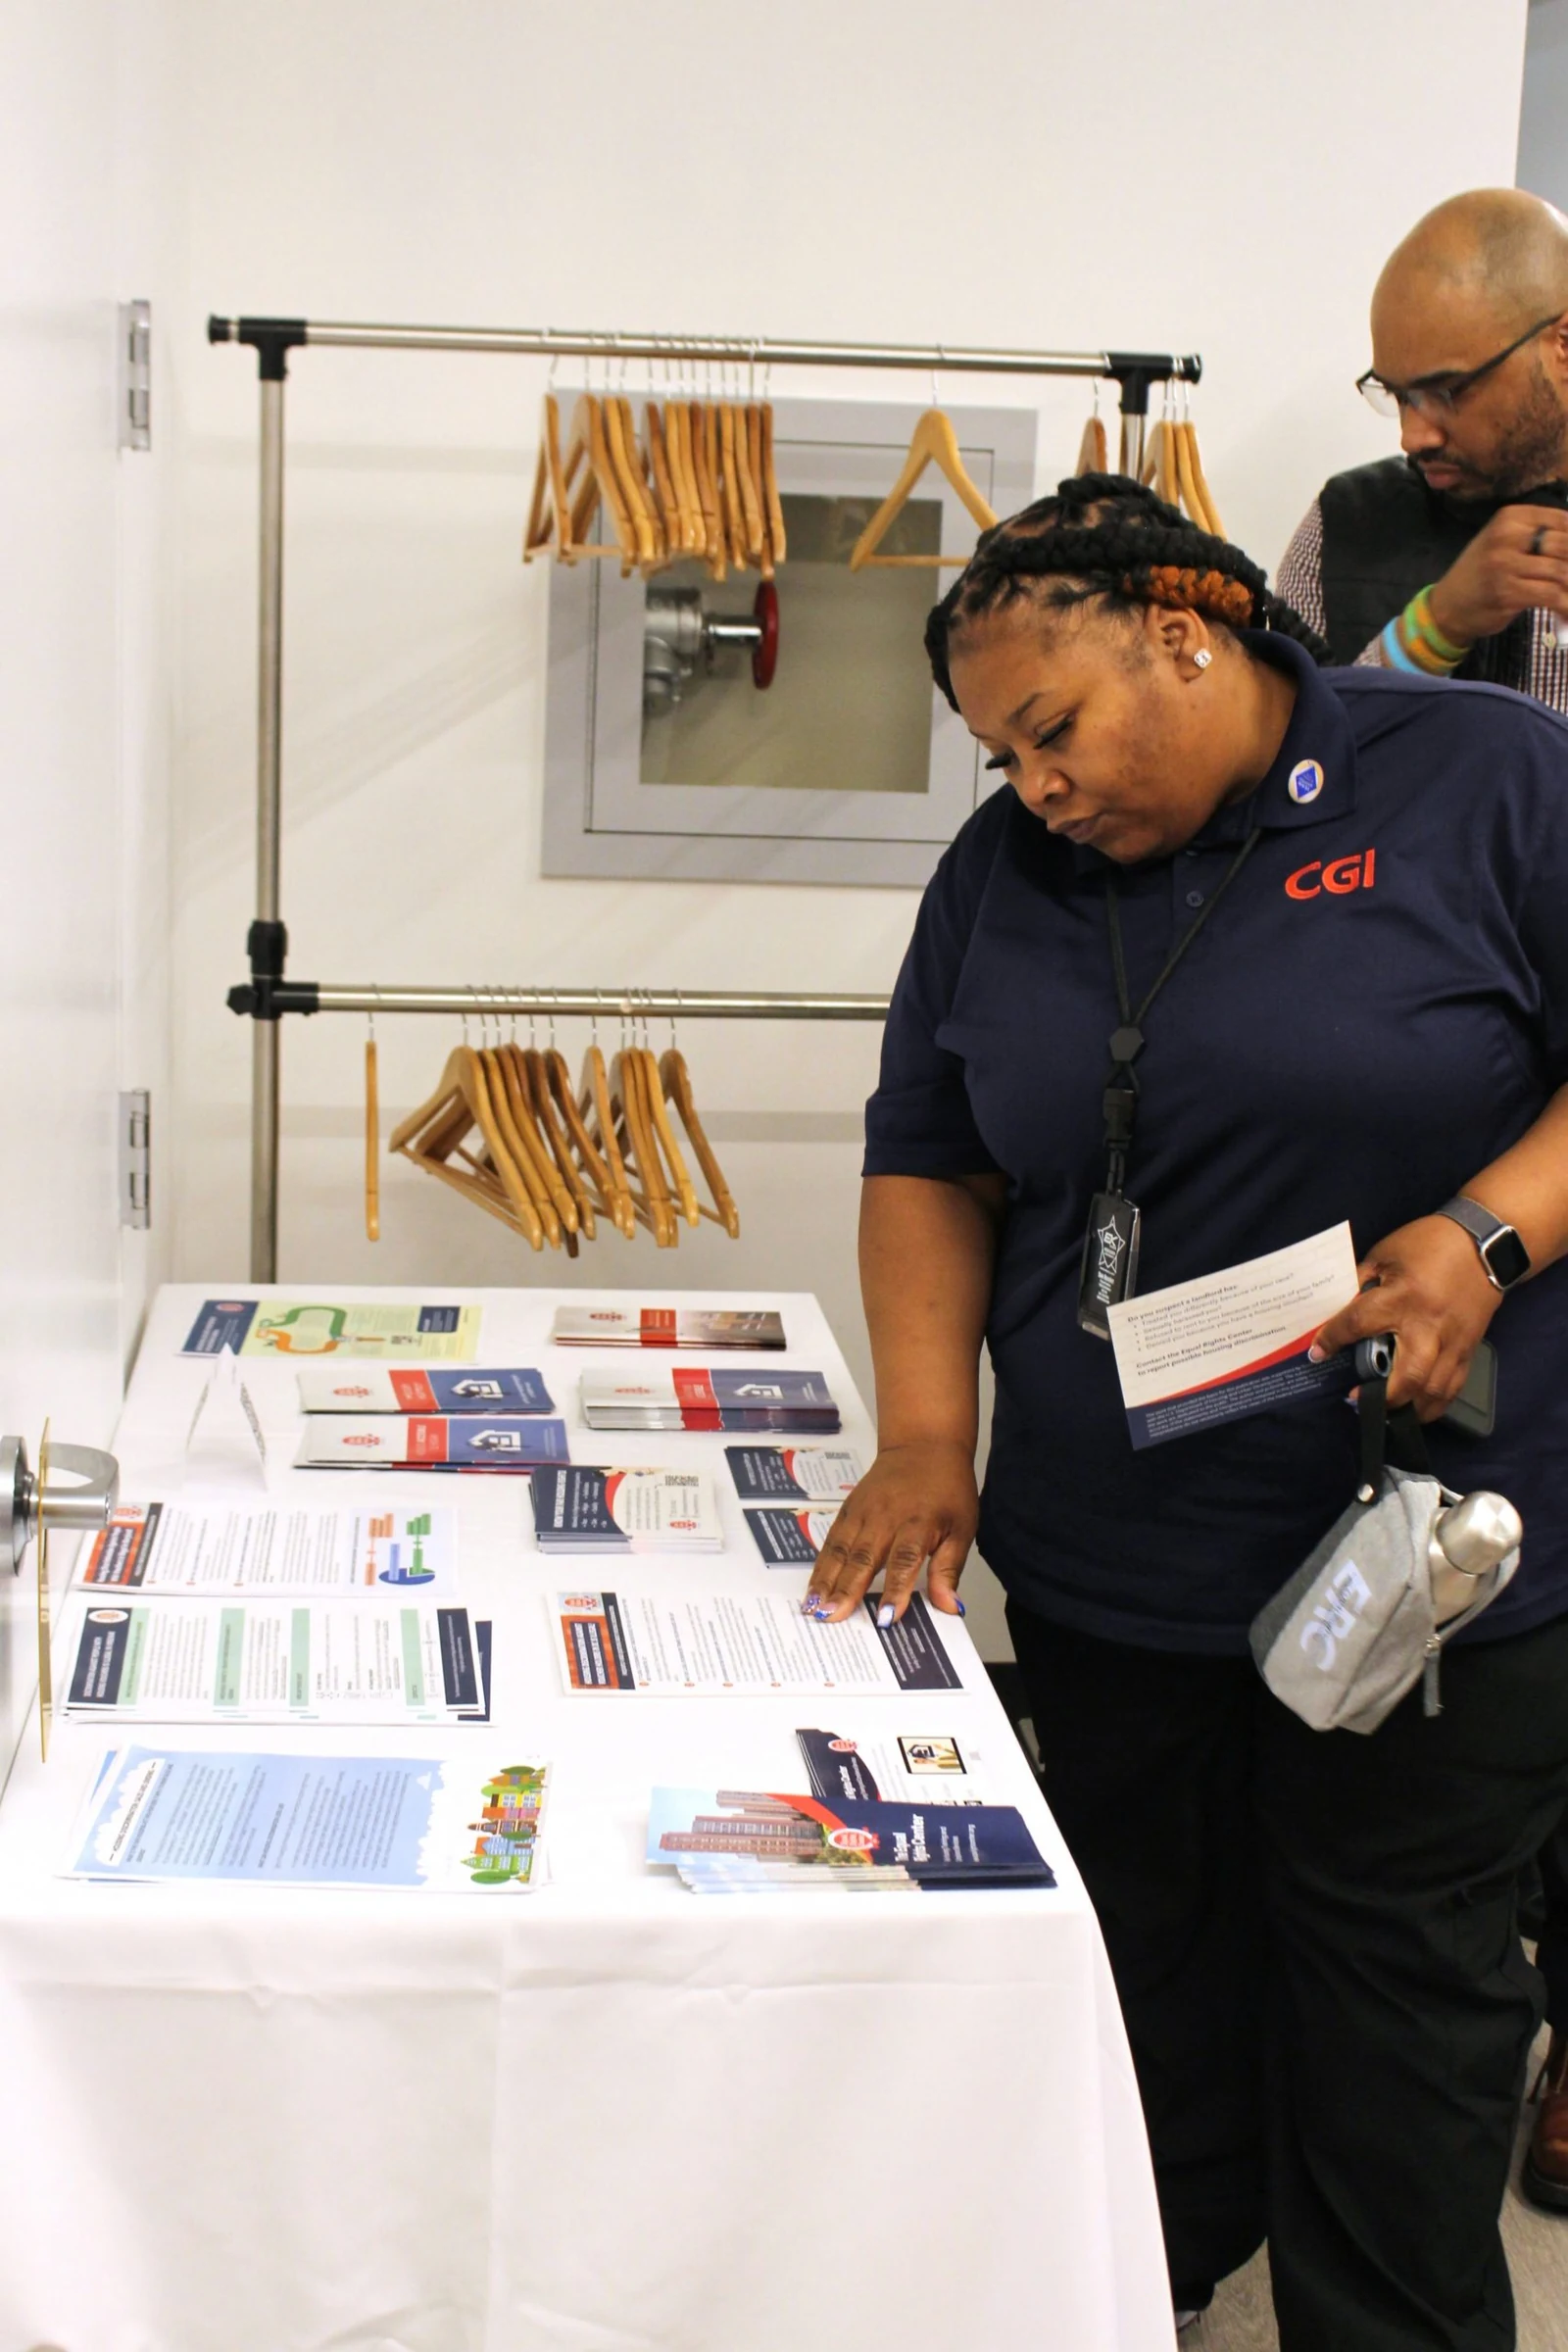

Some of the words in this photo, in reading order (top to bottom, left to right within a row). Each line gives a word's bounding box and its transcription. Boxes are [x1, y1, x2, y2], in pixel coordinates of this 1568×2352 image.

[1285, 848, 1376, 900] CGI
[1228, 1328, 1251, 1339] Center
[1300, 1559, 1372, 1671] ERC
[893, 1832, 910, 1852] Equal
[910, 1814, 925, 1845] Center
